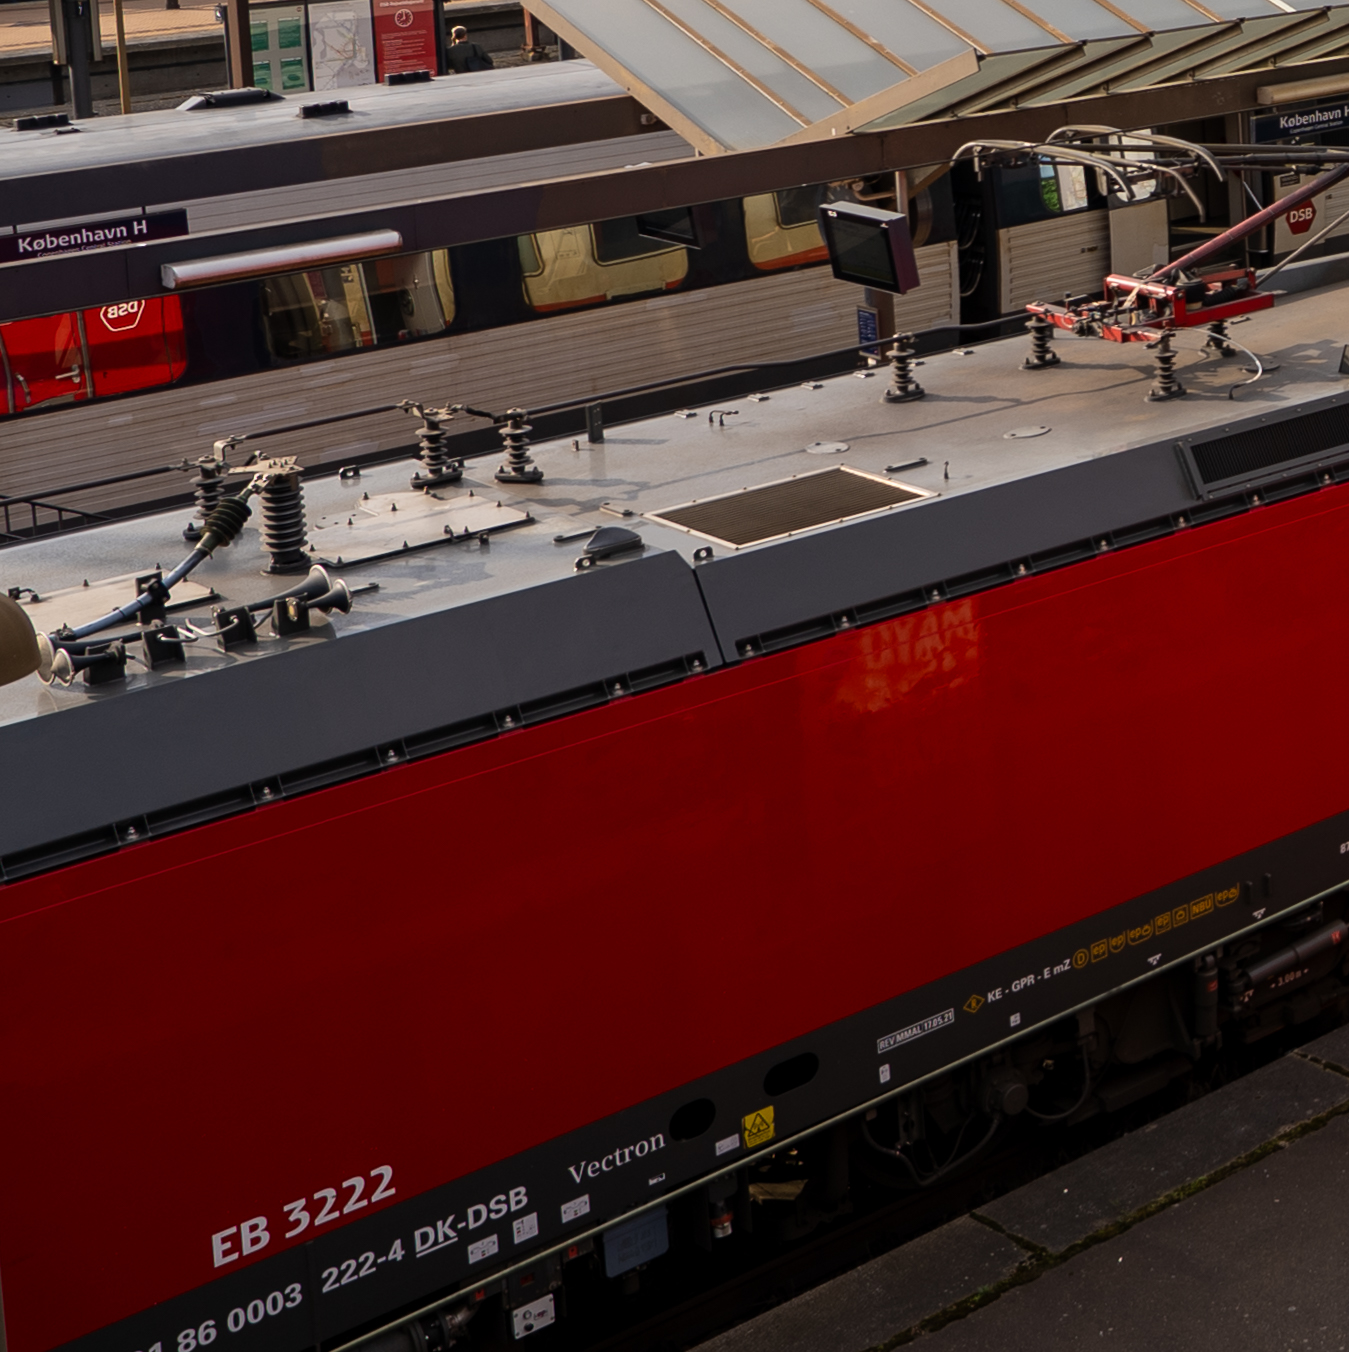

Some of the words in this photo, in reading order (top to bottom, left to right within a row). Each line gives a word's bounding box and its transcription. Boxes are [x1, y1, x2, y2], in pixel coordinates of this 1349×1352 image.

[1280, 107, 1341, 129] København
[1290, 206, 1313, 223] DSB
[18, 225, 127, 253] København
[133, 219, 148, 236] H
[987, 988, 1002, 1003] KE
[1011, 973, 1035, 993] GPR
[1043, 968, 1051, 980] E
[1053, 959, 1071, 975] mZ
[880, 1037, 896, 1049] REV
[568, 1131, 666, 1185] Vectron
[211, 1215, 271, 1269] EB
[282, 1164, 397, 1240] 3222
[177, 1319, 217, 1352] 86
[227, 1282, 303, 1333] 0003
[320, 1239, 405, 1294] 222-4
[414, 1185, 529, 1256] DK-DSB
